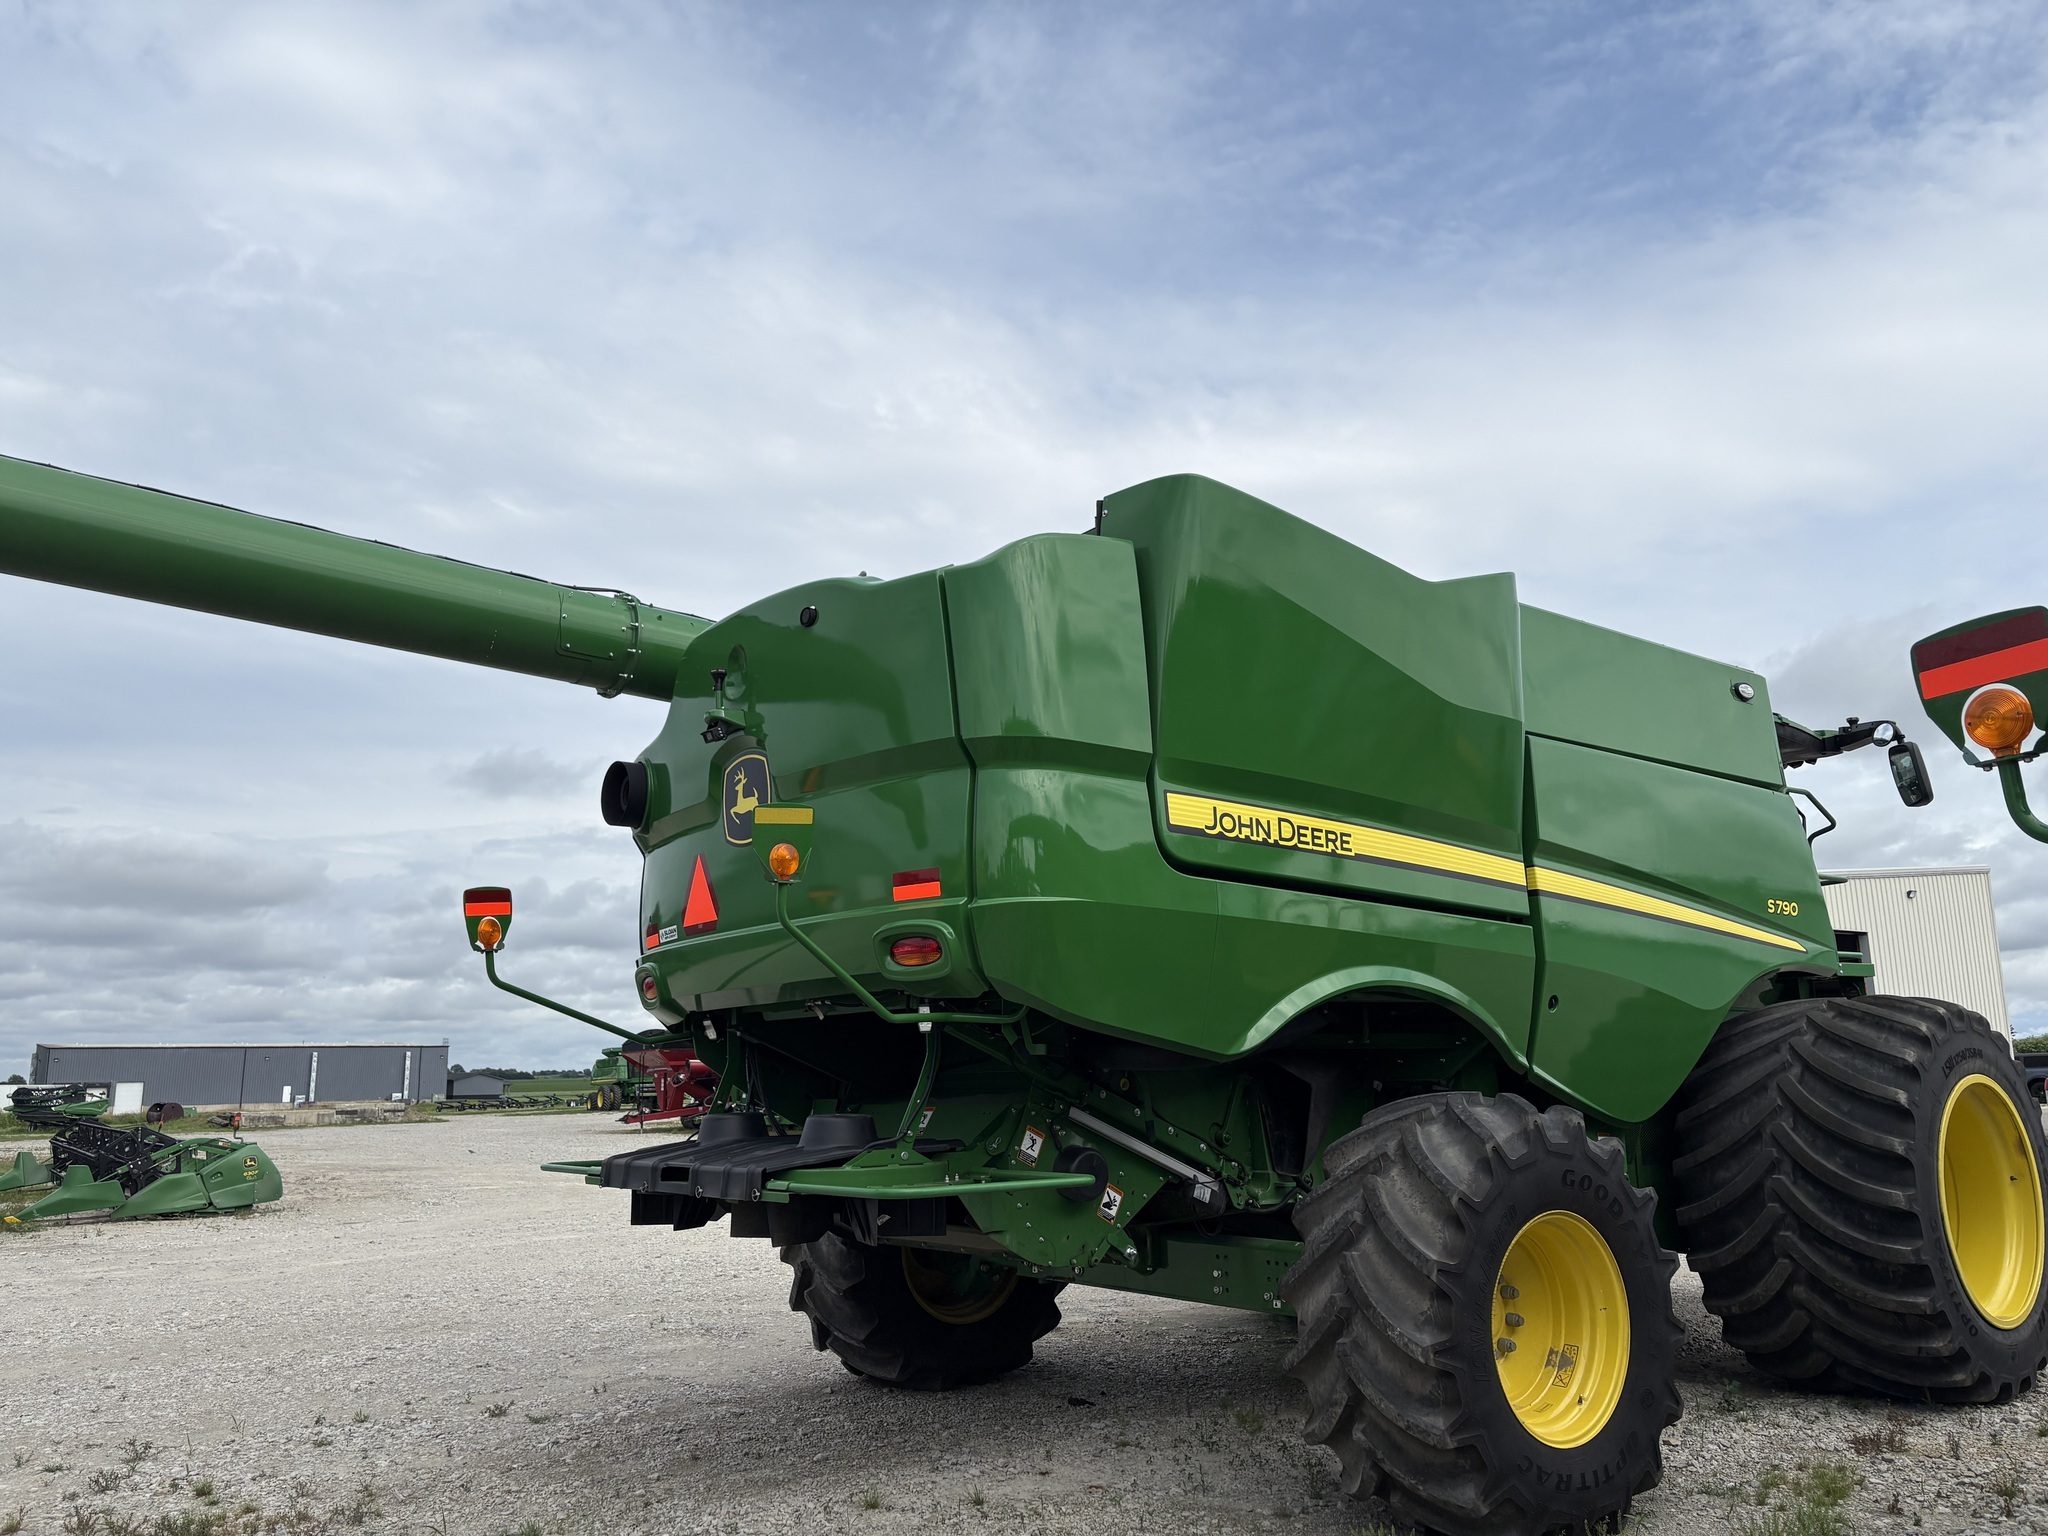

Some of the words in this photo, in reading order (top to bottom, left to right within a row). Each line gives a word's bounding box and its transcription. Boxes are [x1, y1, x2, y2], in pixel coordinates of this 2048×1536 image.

[1204, 806, 1273, 841] JOHN
[1277, 817, 1354, 854] DEERE
[1767, 899, 1799, 916] S790
